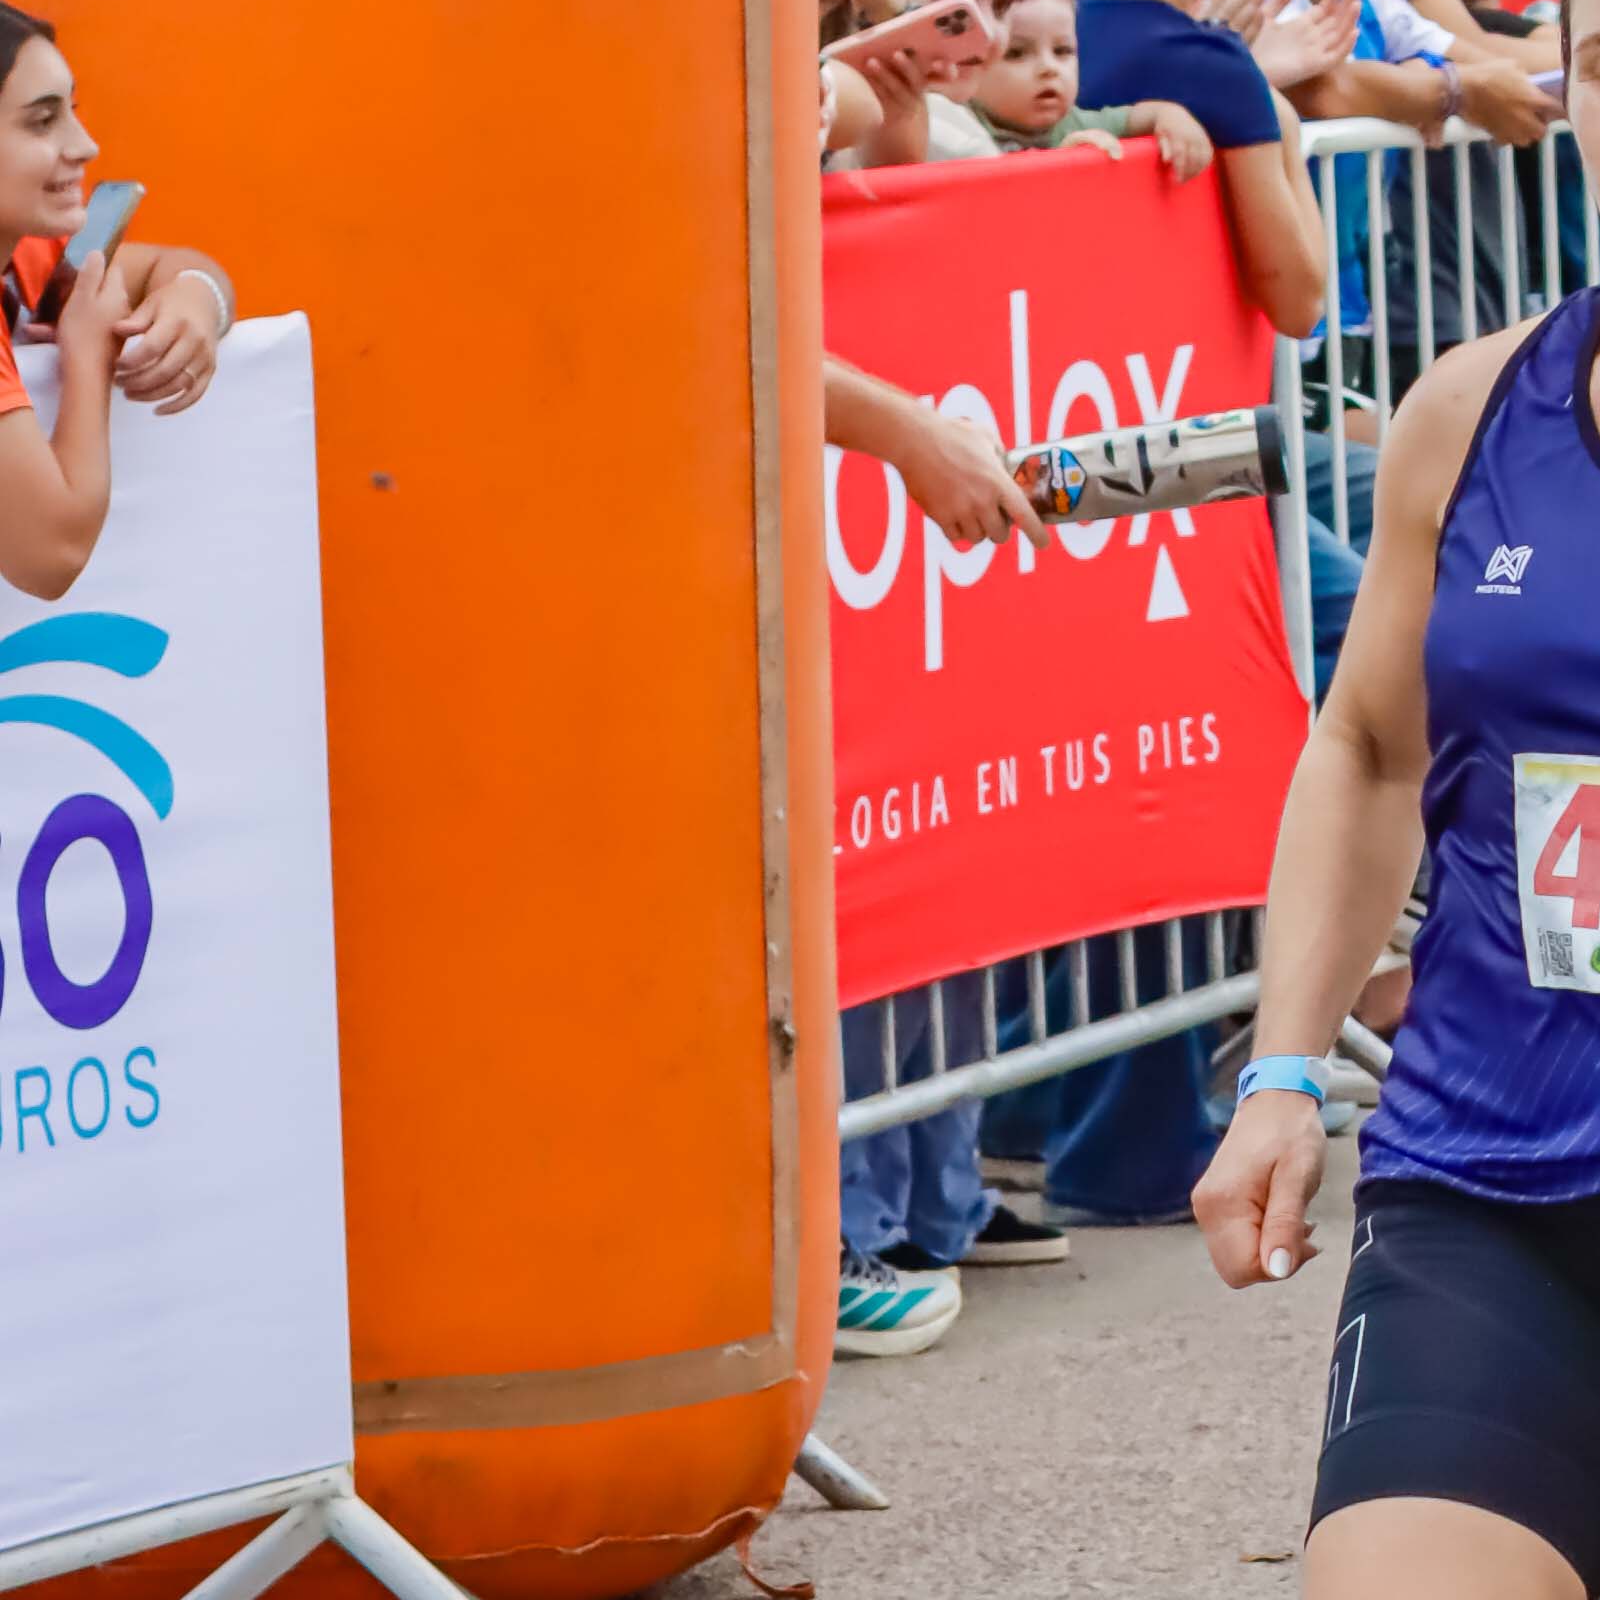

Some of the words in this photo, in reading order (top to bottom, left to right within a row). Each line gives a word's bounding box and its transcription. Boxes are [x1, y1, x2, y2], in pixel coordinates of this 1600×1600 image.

[833, 776, 949, 855] OGIA
[977, 756, 1018, 815] EN
[1040, 733, 1111, 796] TUS
[1138, 713, 1220, 774] PIES
[0, 792, 153, 1030] O
[0, 1046, 160, 1153] ROS
